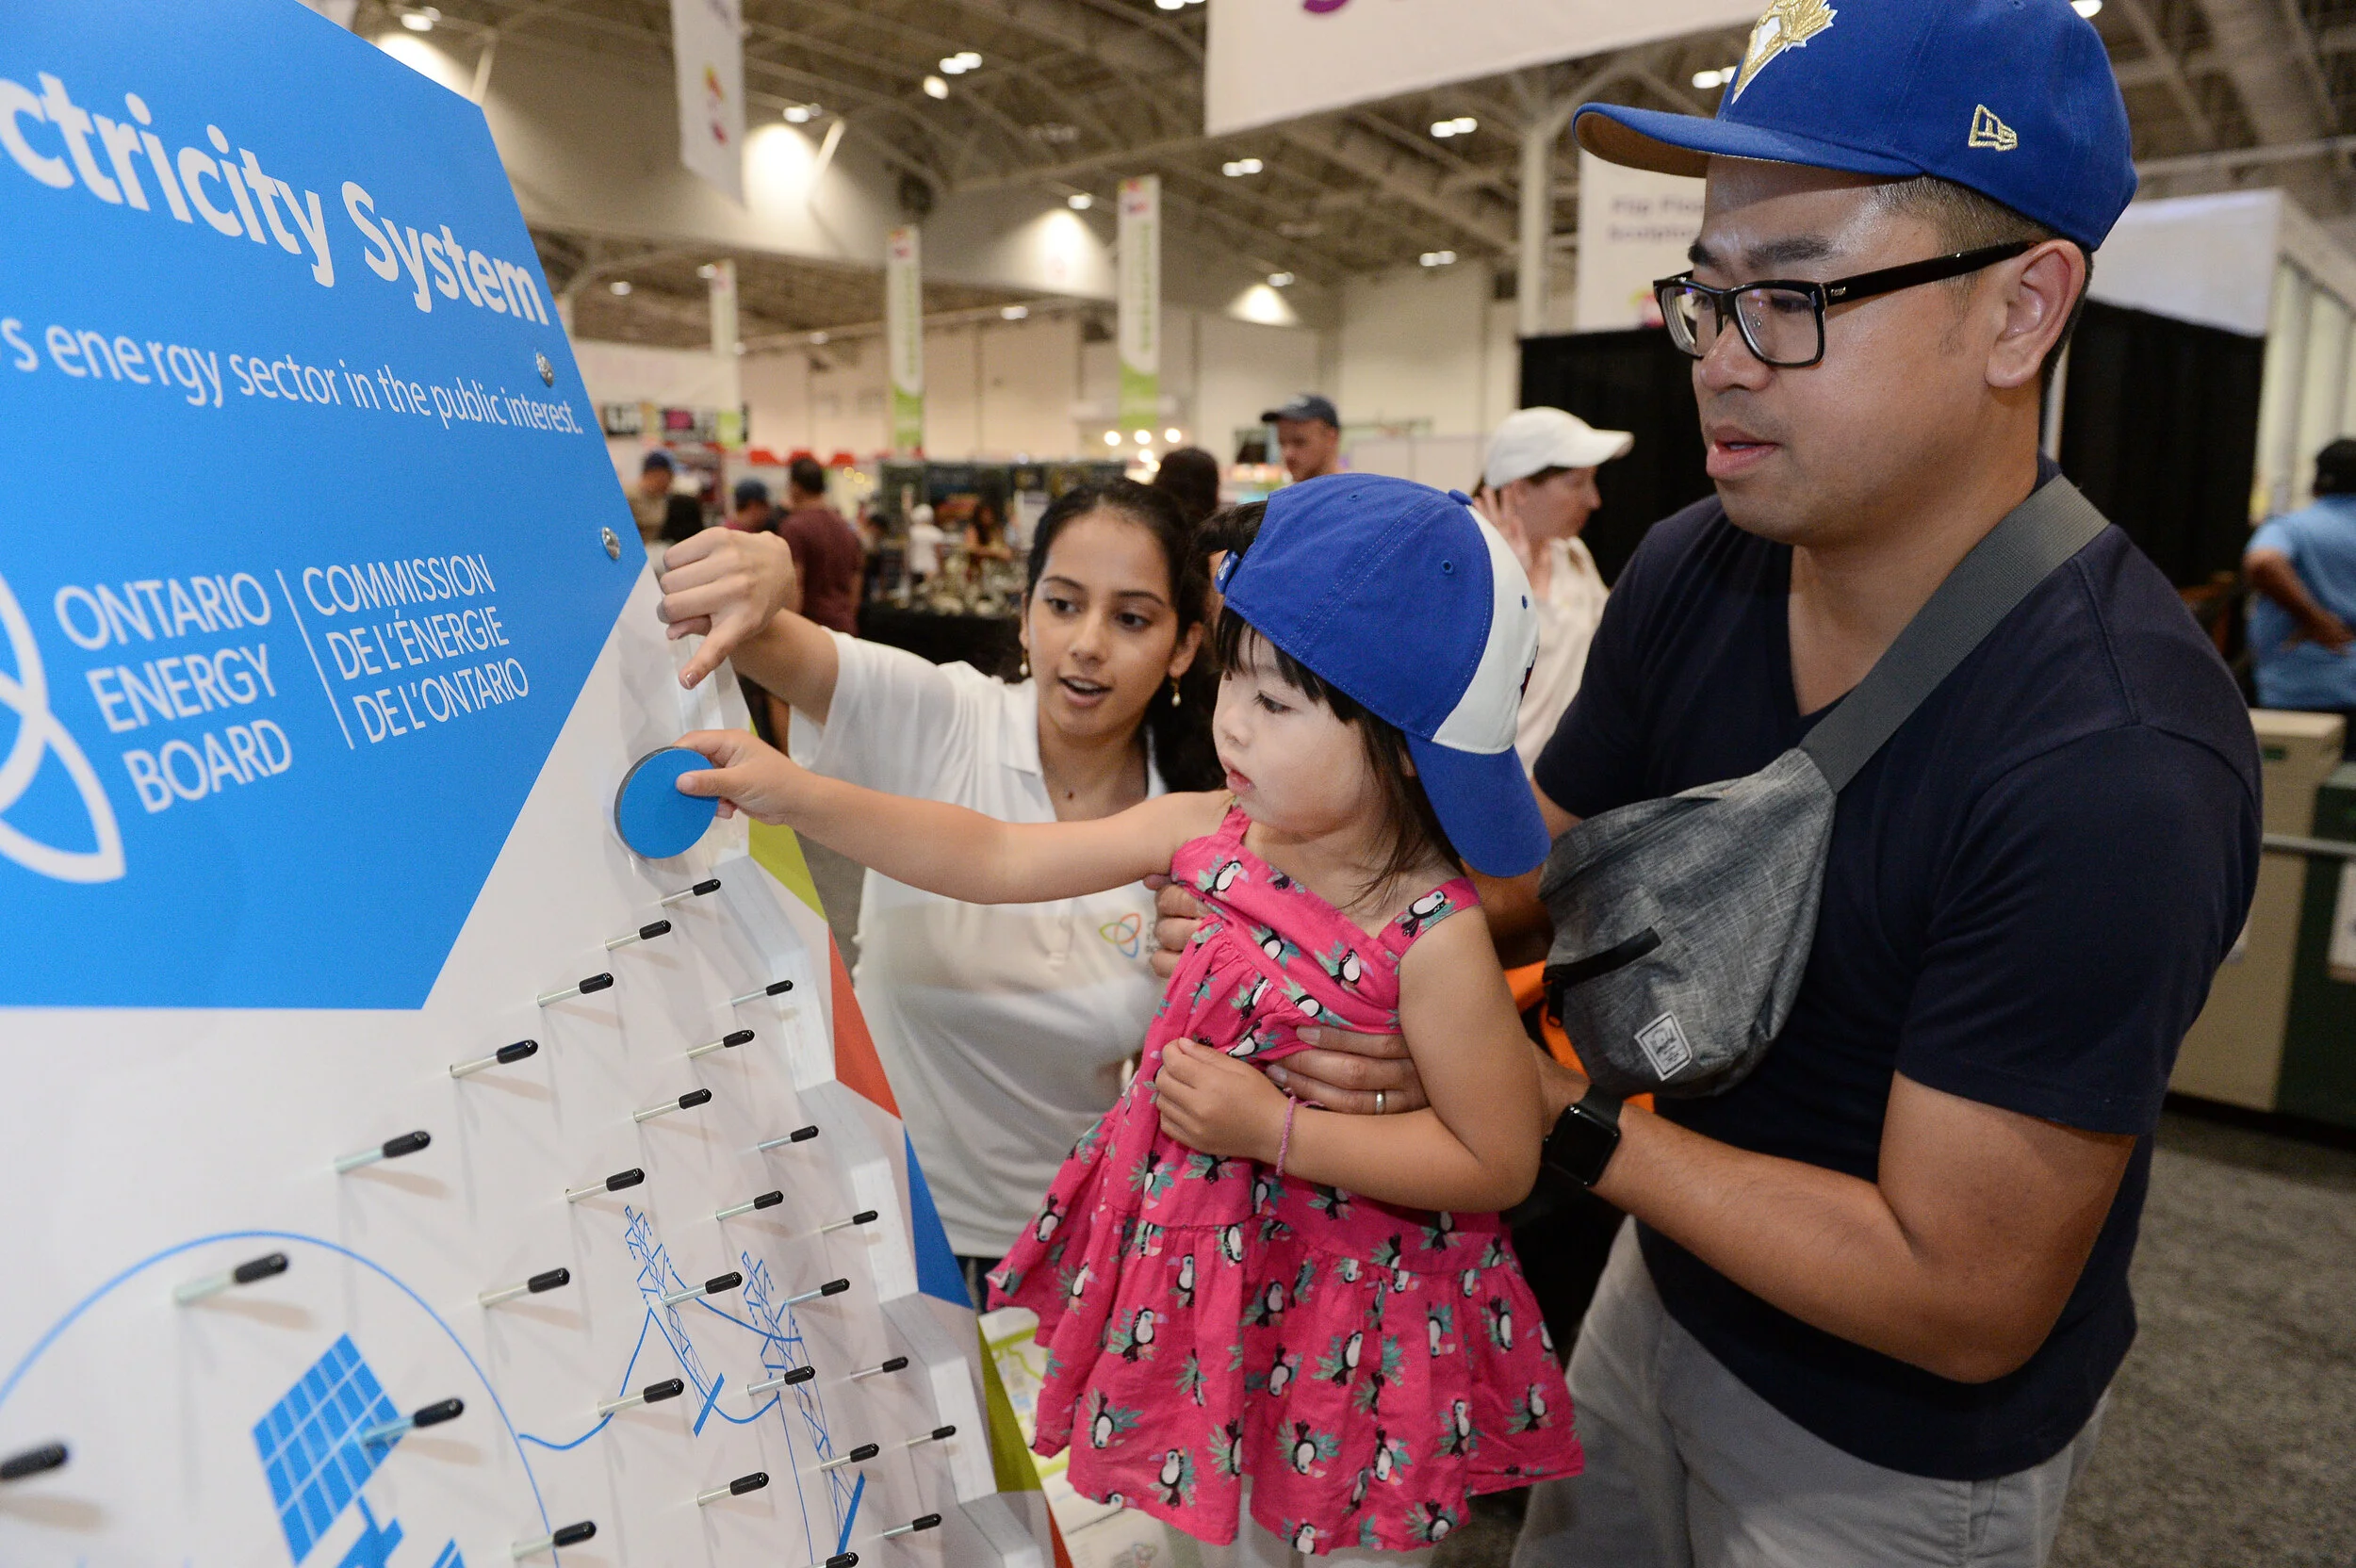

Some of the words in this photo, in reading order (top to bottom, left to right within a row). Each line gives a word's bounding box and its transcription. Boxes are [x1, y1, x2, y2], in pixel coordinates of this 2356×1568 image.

[341, 180, 549, 326] System
[46, 325, 223, 409] energy
[230, 353, 342, 405] sector
[339, 359, 380, 410] in
[377, 365, 432, 416] the
[430, 376, 509, 430] public
[500, 386, 583, 434] interest.
[55, 572, 271, 650] ONTARIO
[302, 553, 497, 616] COMMISSION
[325, 627, 383, 680] DE
[372, 606, 510, 671] L'ÉNERGIE
[87, 645, 276, 733] ENERGY
[352, 688, 408, 743] DE
[397, 657, 530, 730] L'ONTARIO
[123, 719, 292, 813] BOARD
